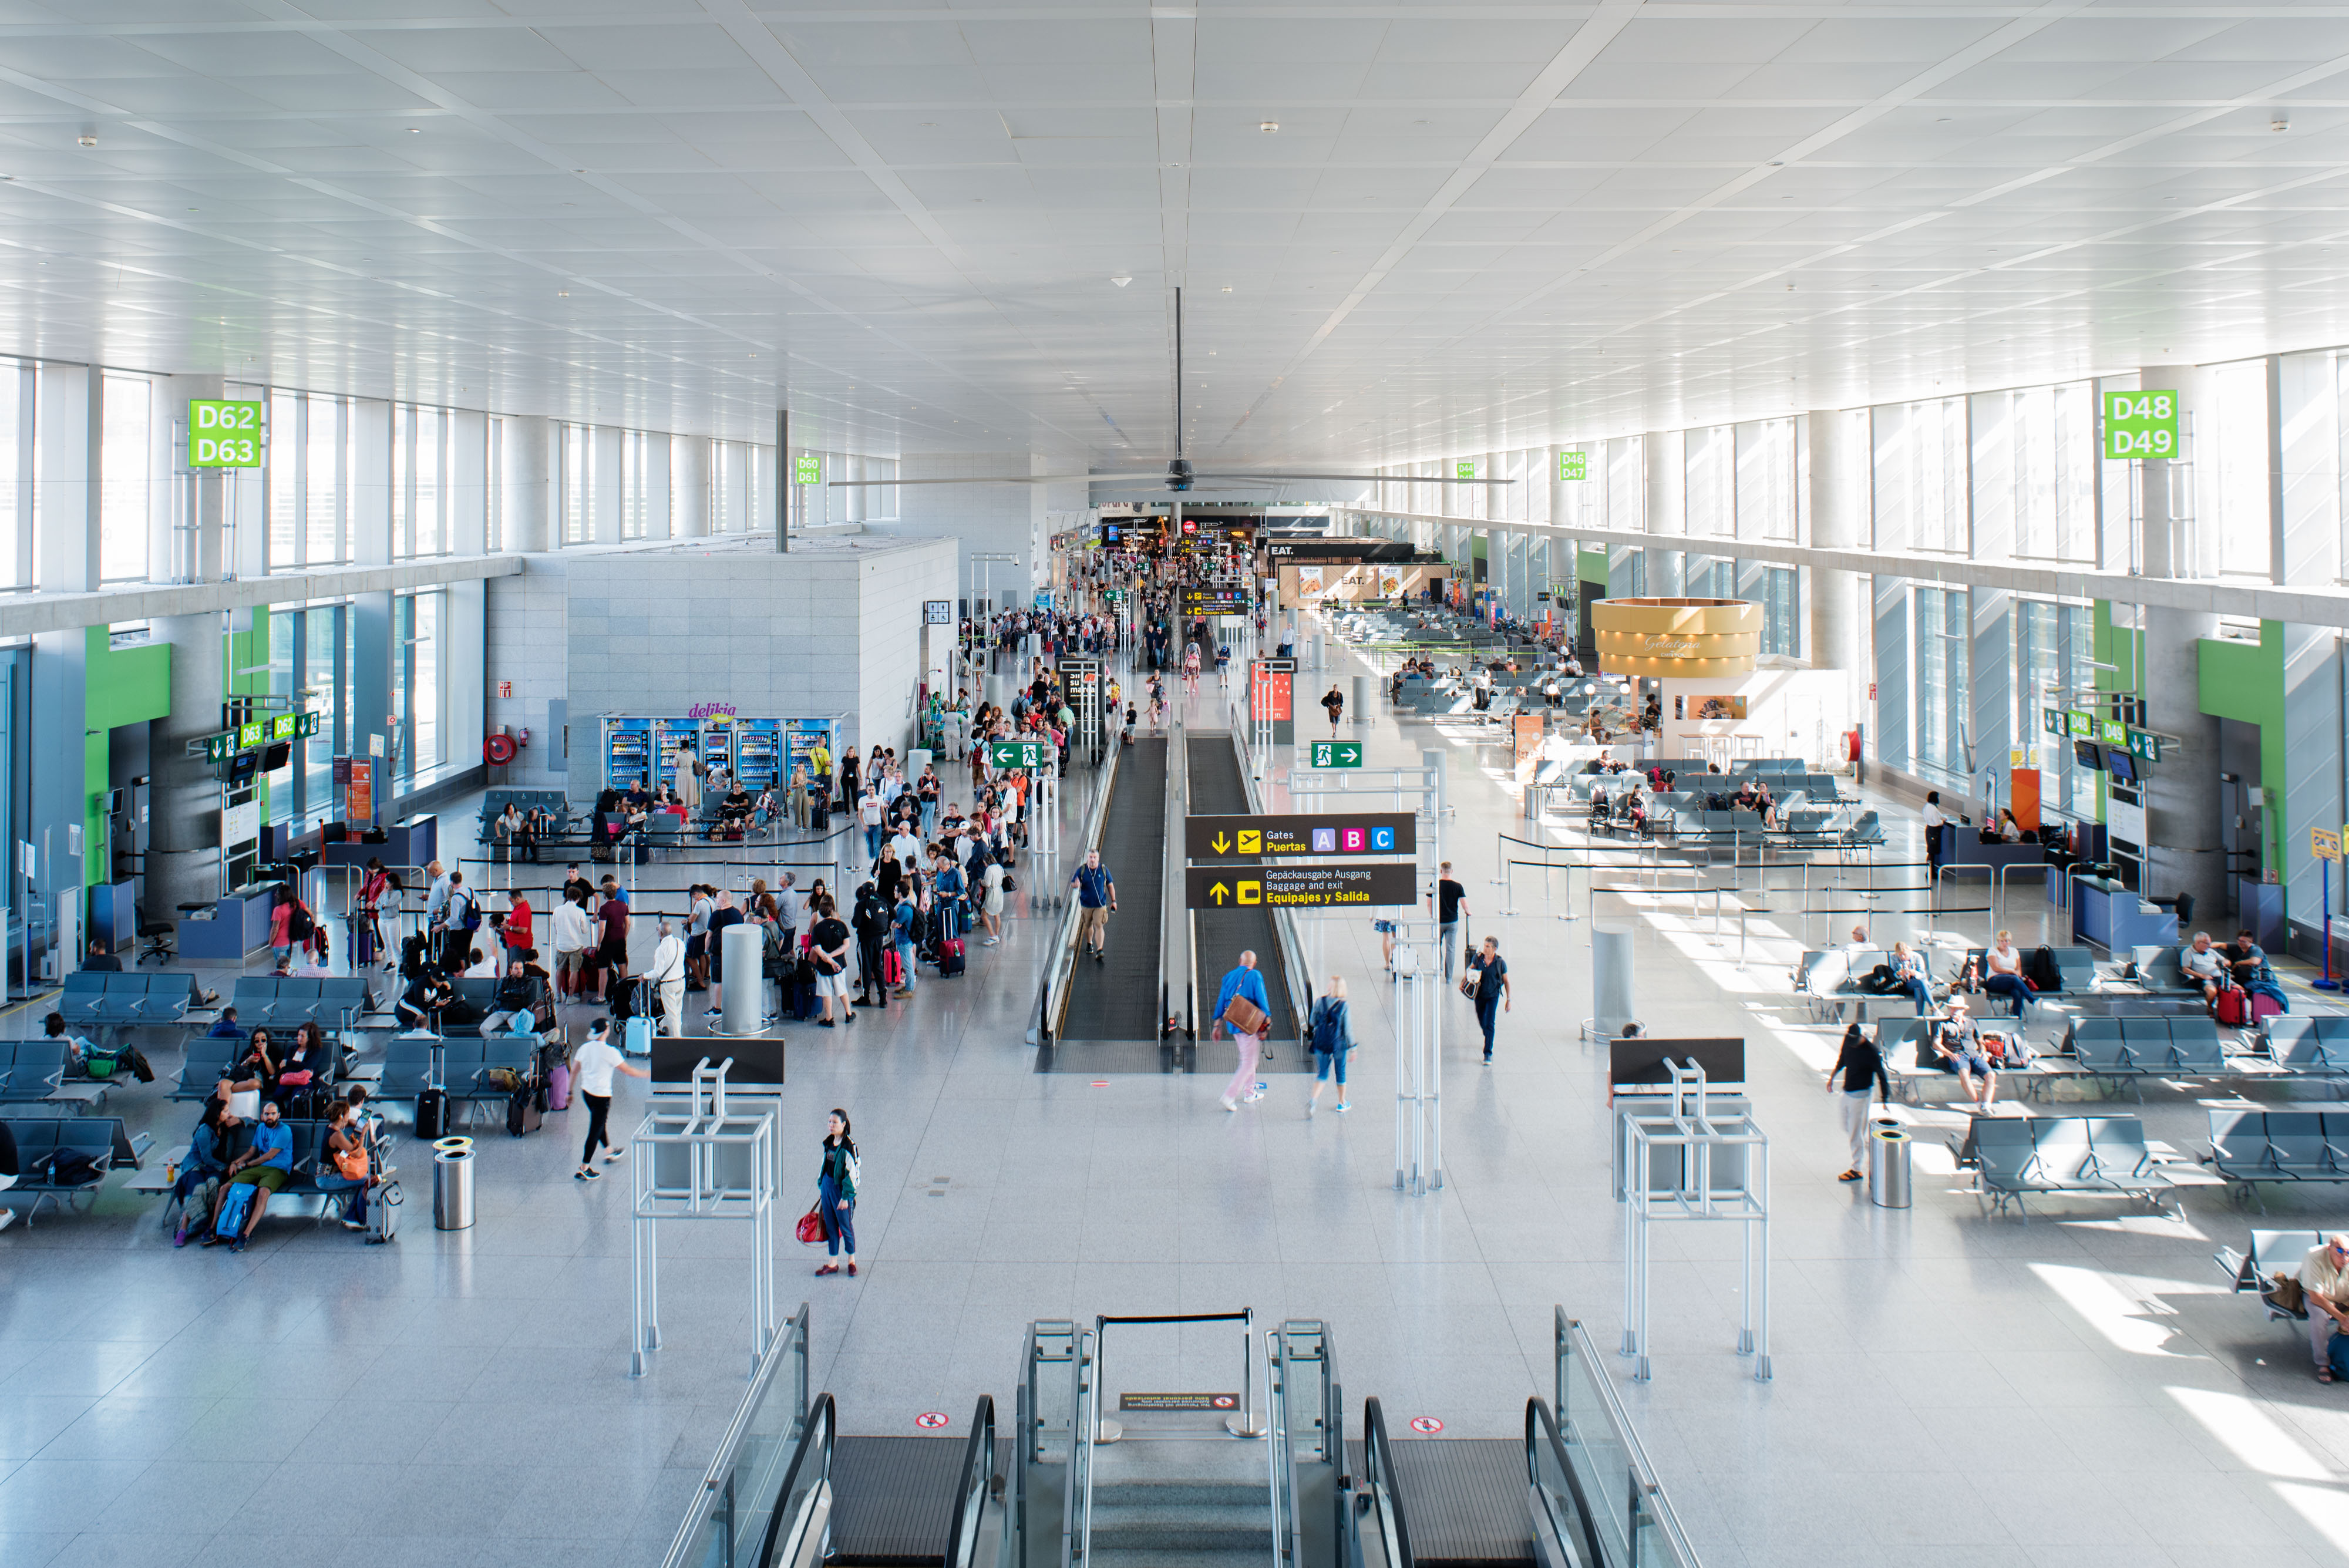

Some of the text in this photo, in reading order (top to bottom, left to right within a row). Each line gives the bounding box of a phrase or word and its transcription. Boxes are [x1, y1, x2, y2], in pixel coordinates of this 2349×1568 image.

[2113, 396, 2172, 420] D48
[198, 406, 254, 429] D62
[2114, 430, 2172, 453] D49
[198, 439, 254, 463] D63
[799, 459, 818, 469] D60
[1563, 454, 1584, 465] D46
[1459, 465, 1473, 473] D44
[1563, 468, 1584, 478] D47
[799, 472, 817, 482] D61
[1271, 546, 1294, 555] EAT.
[1341, 576, 1364, 585] EAT.
[1644, 635, 1701, 651] Gelateria
[688, 702, 736, 718] delikia
[277, 717, 294, 735] D62
[2071, 714, 2088, 732] D48
[243, 725, 260, 743] D63
[2104, 722, 2123, 741] D49
[1267, 831, 1389, 848] Gates A B C
[1267, 843, 1306, 852] Puertas
[1266, 870, 1371, 881] Gepäckausgabe Ausgang
[1267, 881, 1343, 891] Baggage and exit
[1267, 891, 1369, 905] Equipajes y Salida
